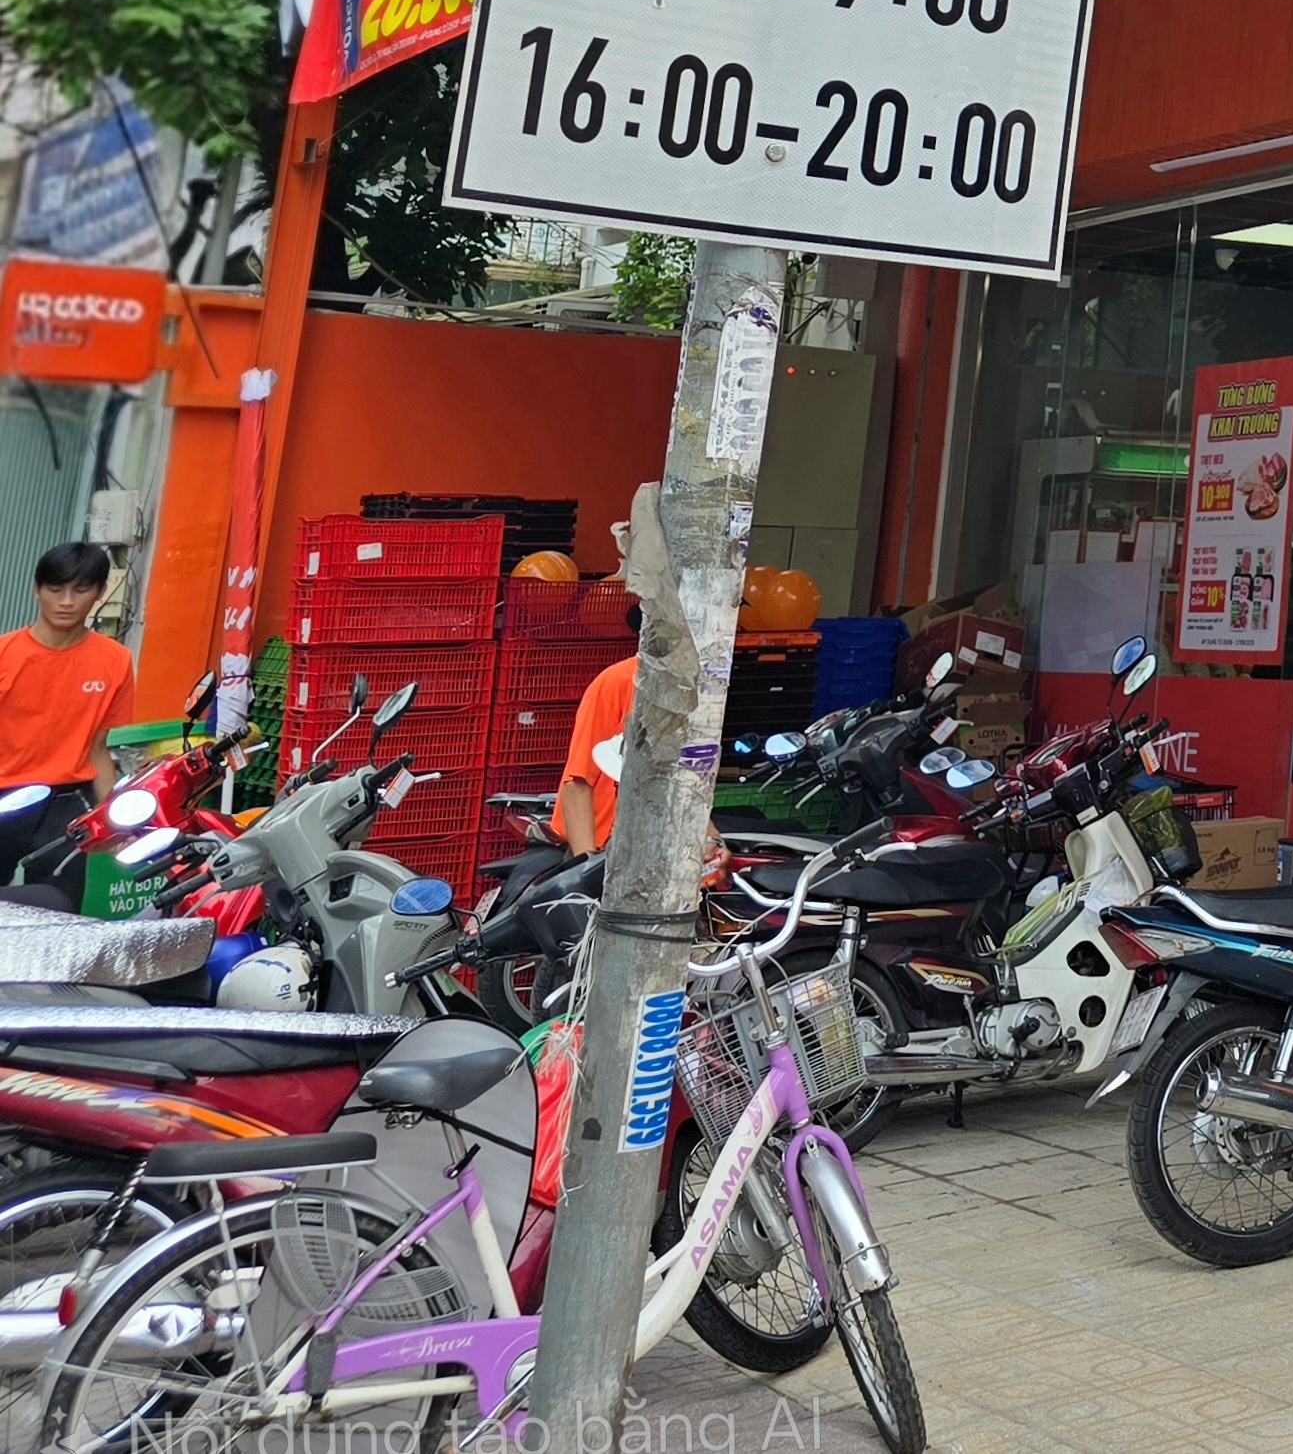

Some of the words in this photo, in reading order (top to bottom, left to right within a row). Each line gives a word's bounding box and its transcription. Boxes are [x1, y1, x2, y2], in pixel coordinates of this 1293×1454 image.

[1210, 415, 1236, 438] KHAI
[109, 896, 135, 913] VÀO
[625, 991, 686, 1146] 0868.611.599
[690, 1146, 753, 1271] ASAMA
